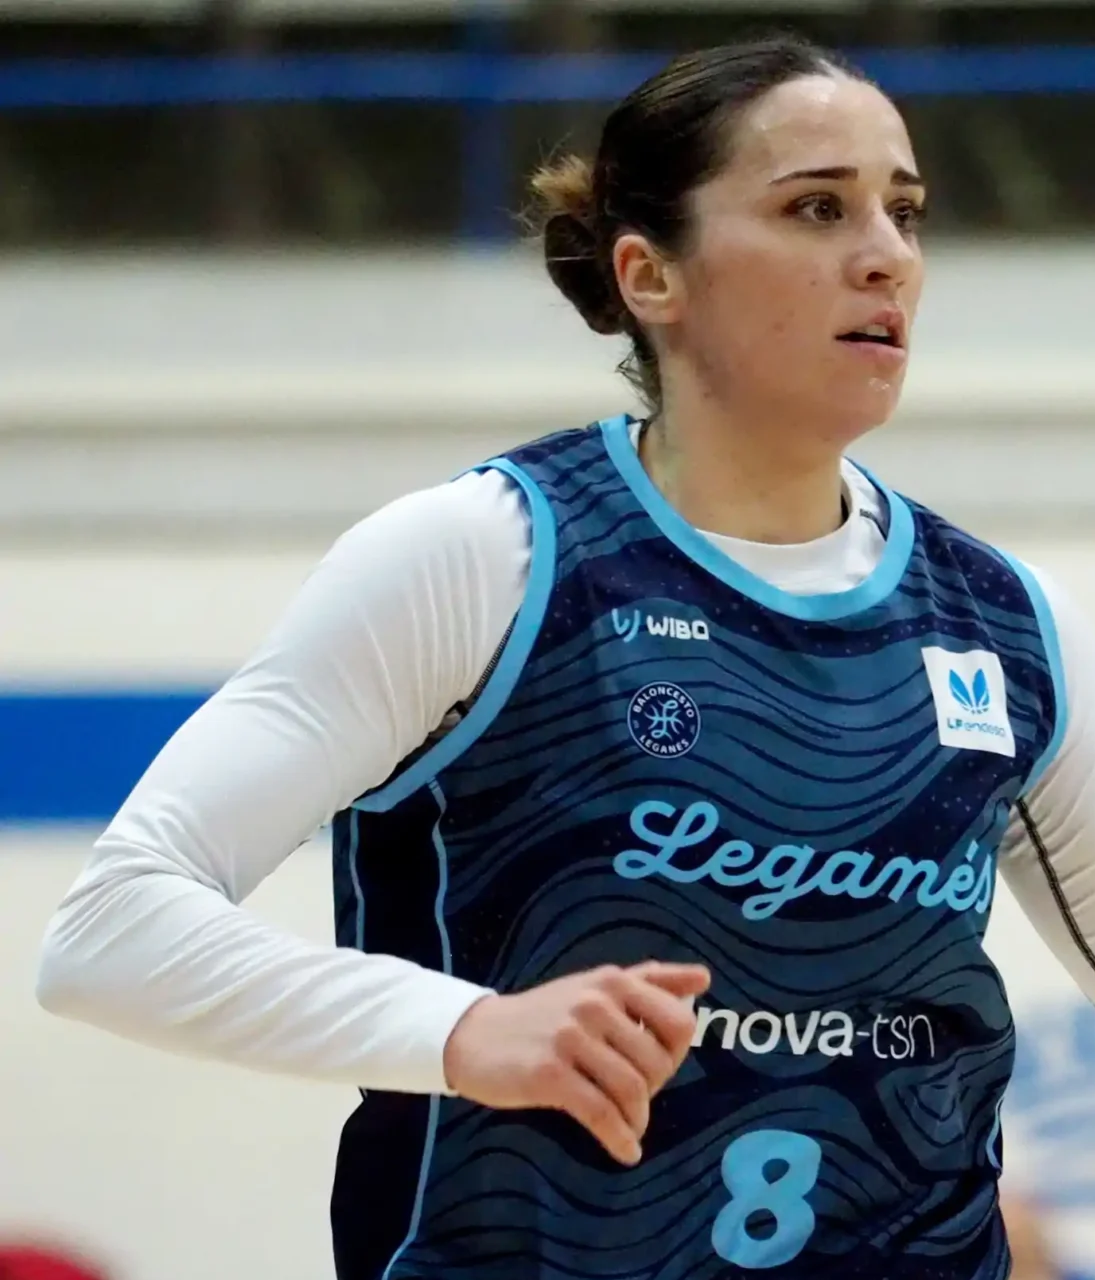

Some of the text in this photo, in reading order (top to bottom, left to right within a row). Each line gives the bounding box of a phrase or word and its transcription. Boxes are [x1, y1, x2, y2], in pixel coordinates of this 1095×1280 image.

[632, 686, 695, 718] BALONCESTO
[613, 800, 992, 921] Leganés
[711, 1129, 822, 1269] 8
